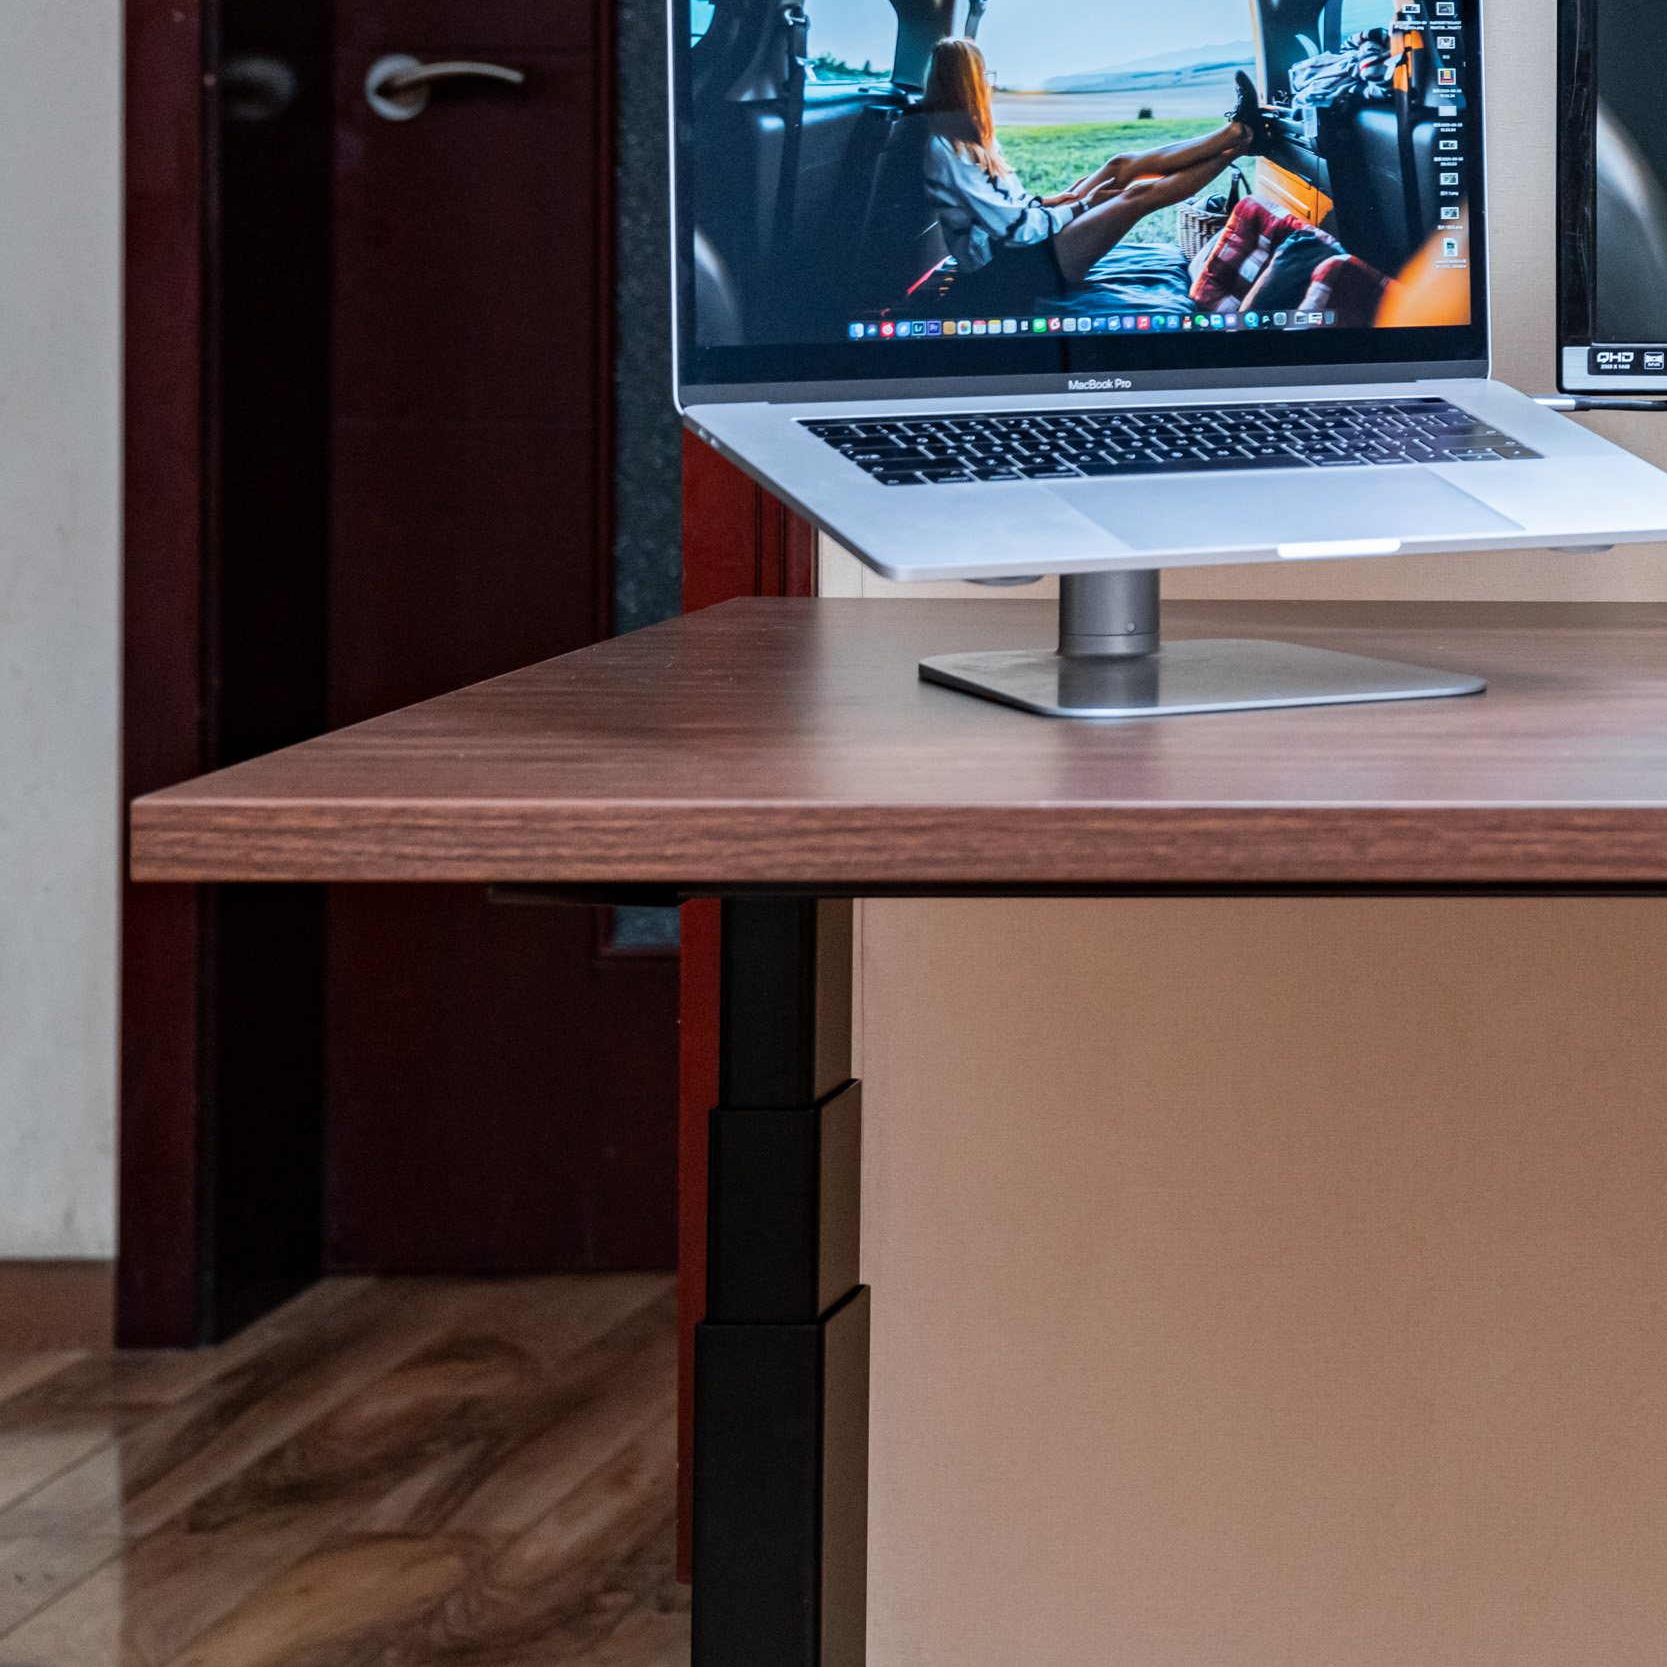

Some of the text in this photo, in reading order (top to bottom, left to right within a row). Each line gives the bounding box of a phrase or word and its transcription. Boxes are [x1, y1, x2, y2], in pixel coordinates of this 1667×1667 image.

[1596, 352, 1635, 363] QHD
[1068, 378, 1132, 390] MacBook Pro
